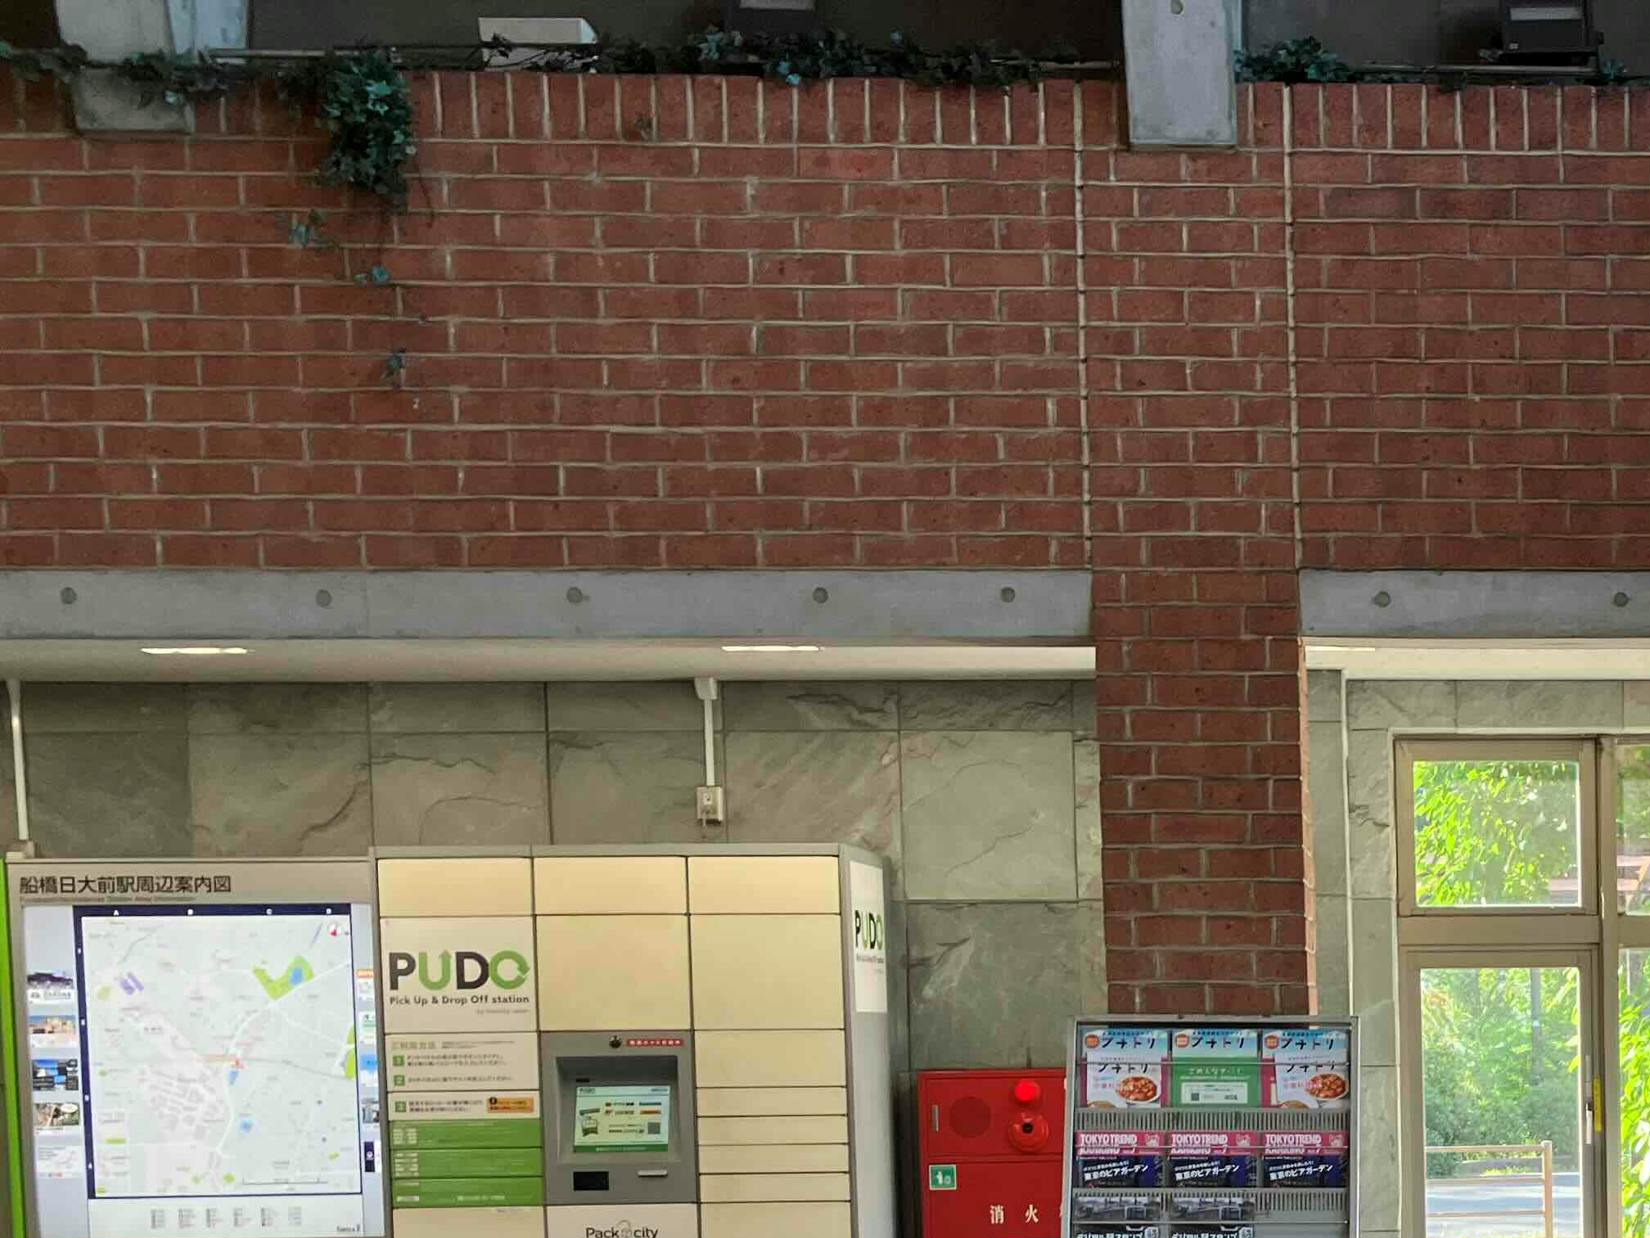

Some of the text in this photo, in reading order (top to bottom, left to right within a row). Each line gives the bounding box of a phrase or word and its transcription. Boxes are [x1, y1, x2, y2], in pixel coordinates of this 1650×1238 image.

[20, 875, 231, 894] 船橋日大前駅周辺案内図
[855, 909, 884, 951] PUDO
[389, 949, 530, 990] PUDO
[390, 994, 530, 1007] Pick Up & Drop Off station
[989, 1203, 1063, 1224] 消火
